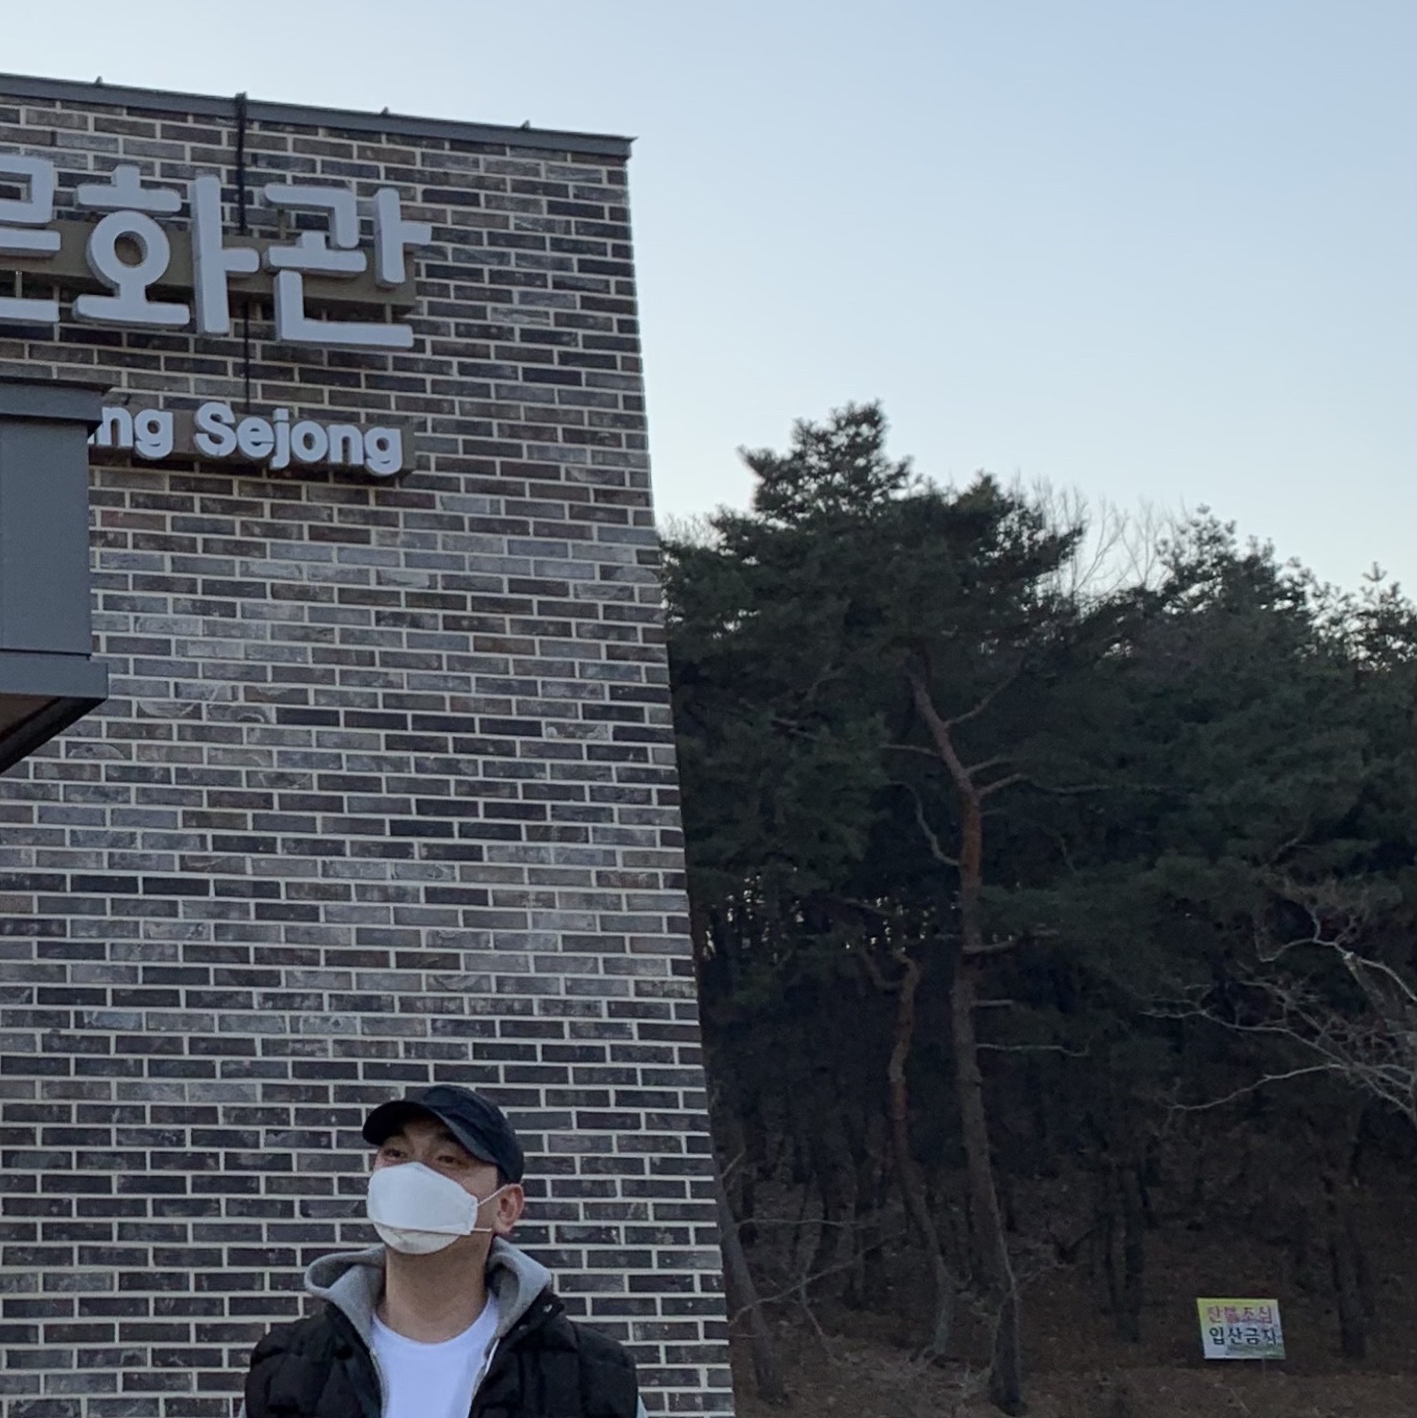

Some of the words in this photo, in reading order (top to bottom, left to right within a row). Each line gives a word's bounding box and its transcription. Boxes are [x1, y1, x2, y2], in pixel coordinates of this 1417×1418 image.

[87, 406, 174, 460] ng
[193, 401, 403, 477] Sejong
[1207, 1305, 1273, 1324] 산불조심
[1209, 1327, 1277, 1346] 입산금지
